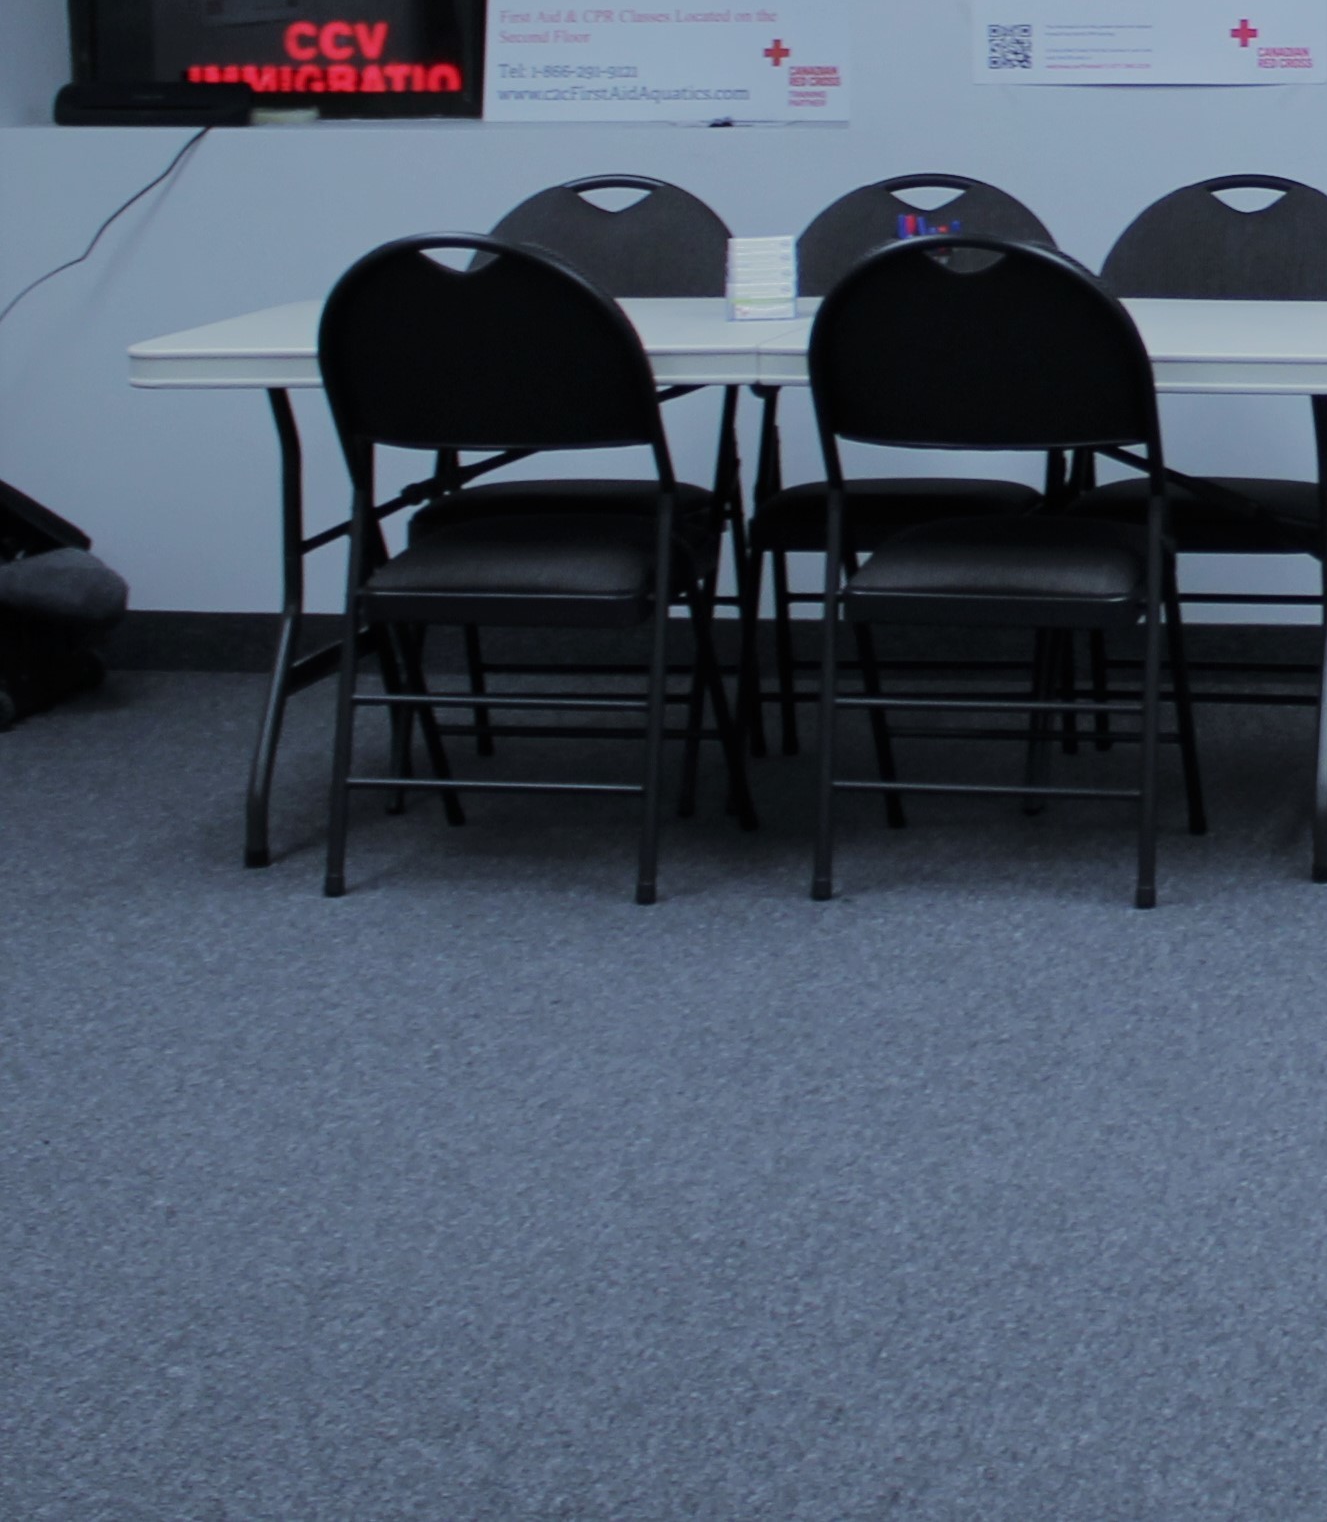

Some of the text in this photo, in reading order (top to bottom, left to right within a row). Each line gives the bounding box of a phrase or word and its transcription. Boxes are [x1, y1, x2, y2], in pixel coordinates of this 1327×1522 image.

[500, 10, 535, 23] First
[538, 10, 562, 23] Aid
[582, 10, 614, 23] CPR
[619, 10, 670, 23] Classes
[674, 9, 730, 23] Located
[734, 13, 752, 23] on
[755, 10, 777, 23] the
[283, 20, 389, 60] CCV
[498, 30, 592, 44] Second Floor
[1258, 47, 1309, 57] CANADIAN
[1258, 58, 1313, 69] RED CROSS
[497, 63, 525, 79] Tel:
[789, 66, 837, 75] CANADIAN
[789, 77, 806, 87] RED
